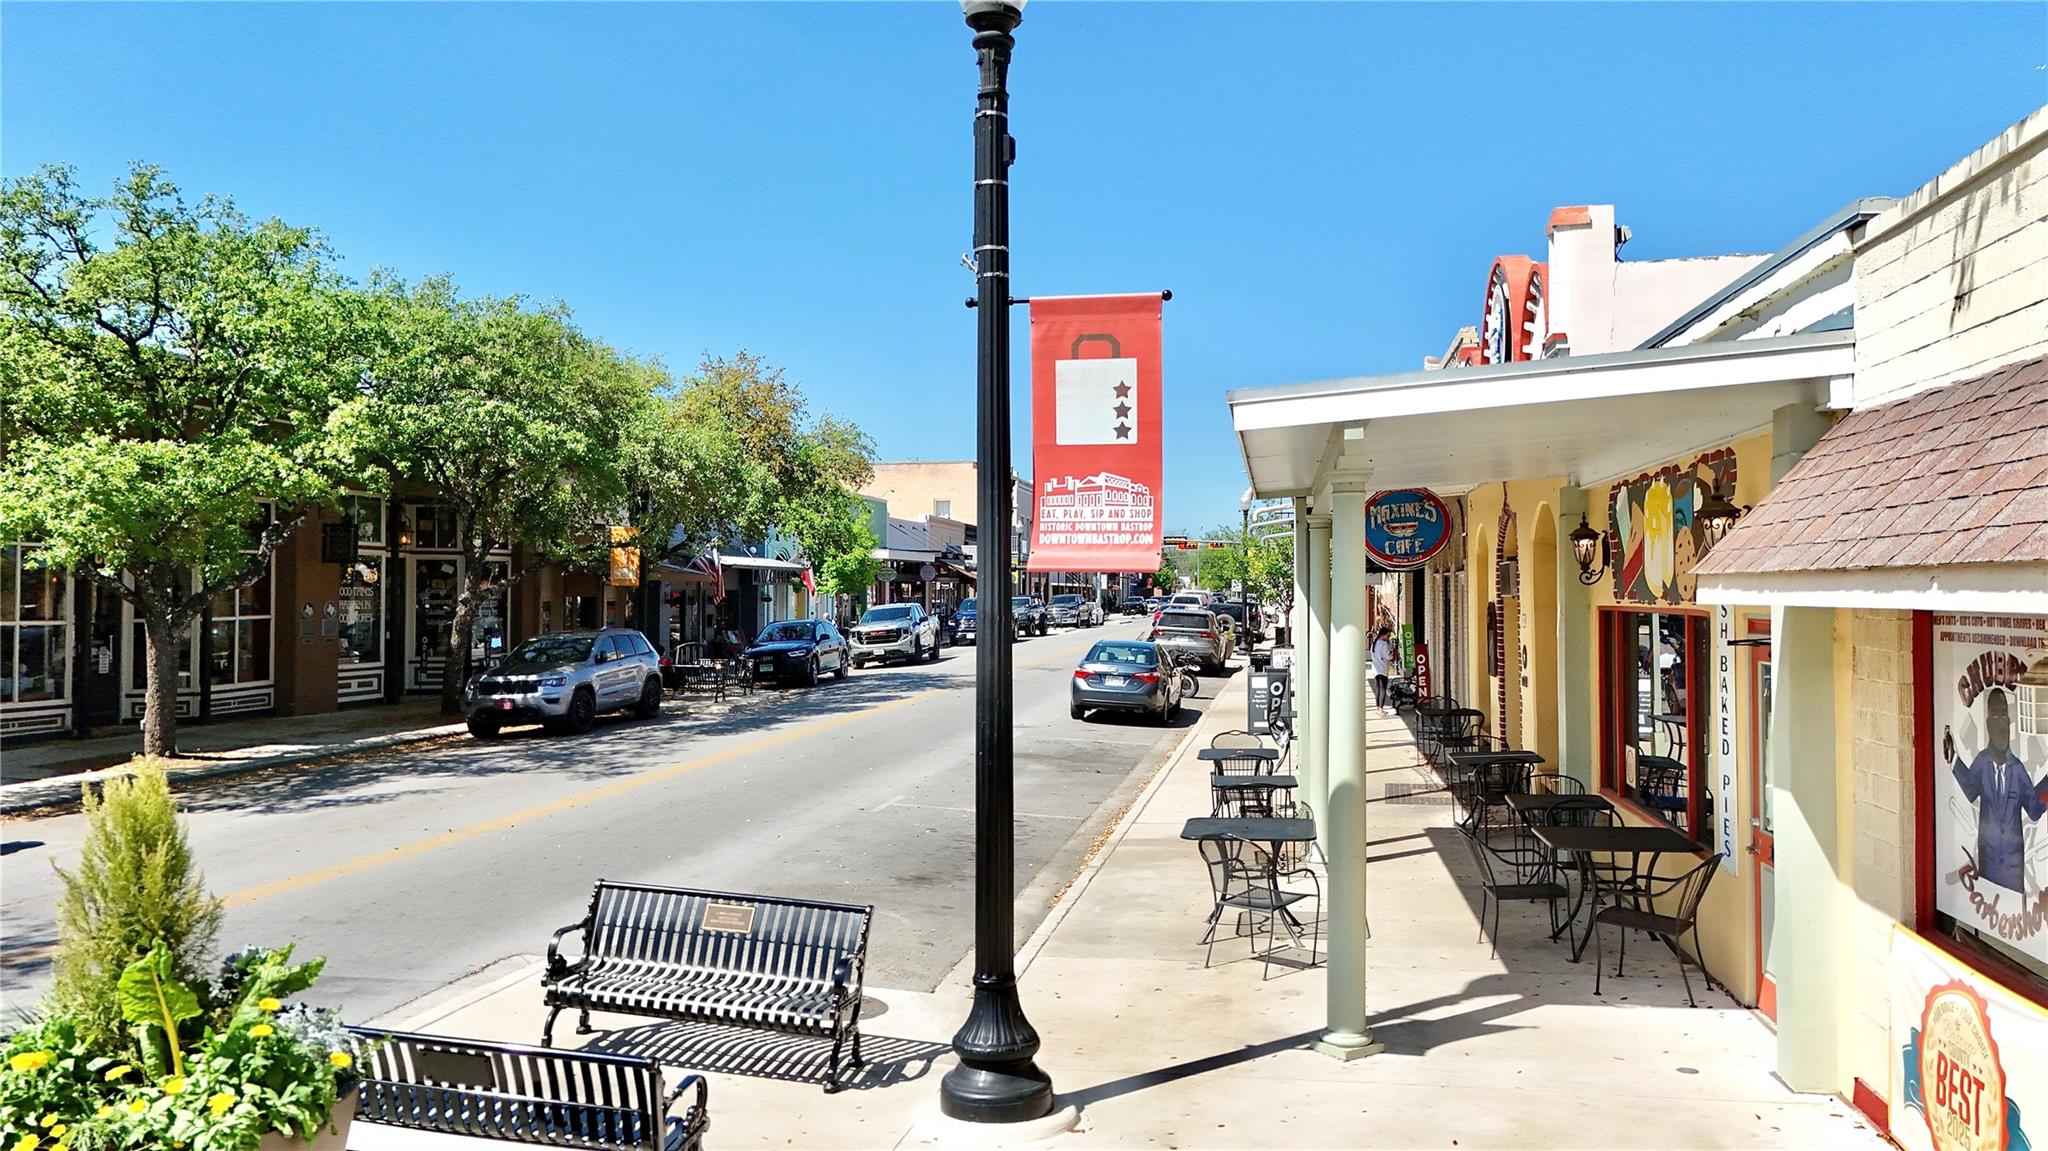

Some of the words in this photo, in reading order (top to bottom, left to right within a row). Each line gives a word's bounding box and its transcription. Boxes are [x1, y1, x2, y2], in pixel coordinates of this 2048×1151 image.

[1040, 522, 1072, 531] HISTORIC
[1075, 523, 1118, 531] DOWNTOWN
[1121, 522, 1153, 531] BASTROP
[1041, 509, 1058, 519] EAT,
[1063, 509, 1086, 519] PLAY,
[1091, 509, 1104, 518] SIP
[1108, 509, 1125, 518] AND
[1130, 509, 1152, 518] SHOP
[1039, 533, 1153, 544] DOWNTOWNBASTROP.COM
[1384, 538, 1424, 555] CAFE
[1404, 631, 1414, 663] OPEN
[1416, 654, 1428, 697] OPEN
[1720, 655, 1730, 756] BAKED
[1722, 774, 1732, 858] PIES
[1936, 1050, 1985, 1136] BEST
[1947, 1111, 1971, 1150] 2025
